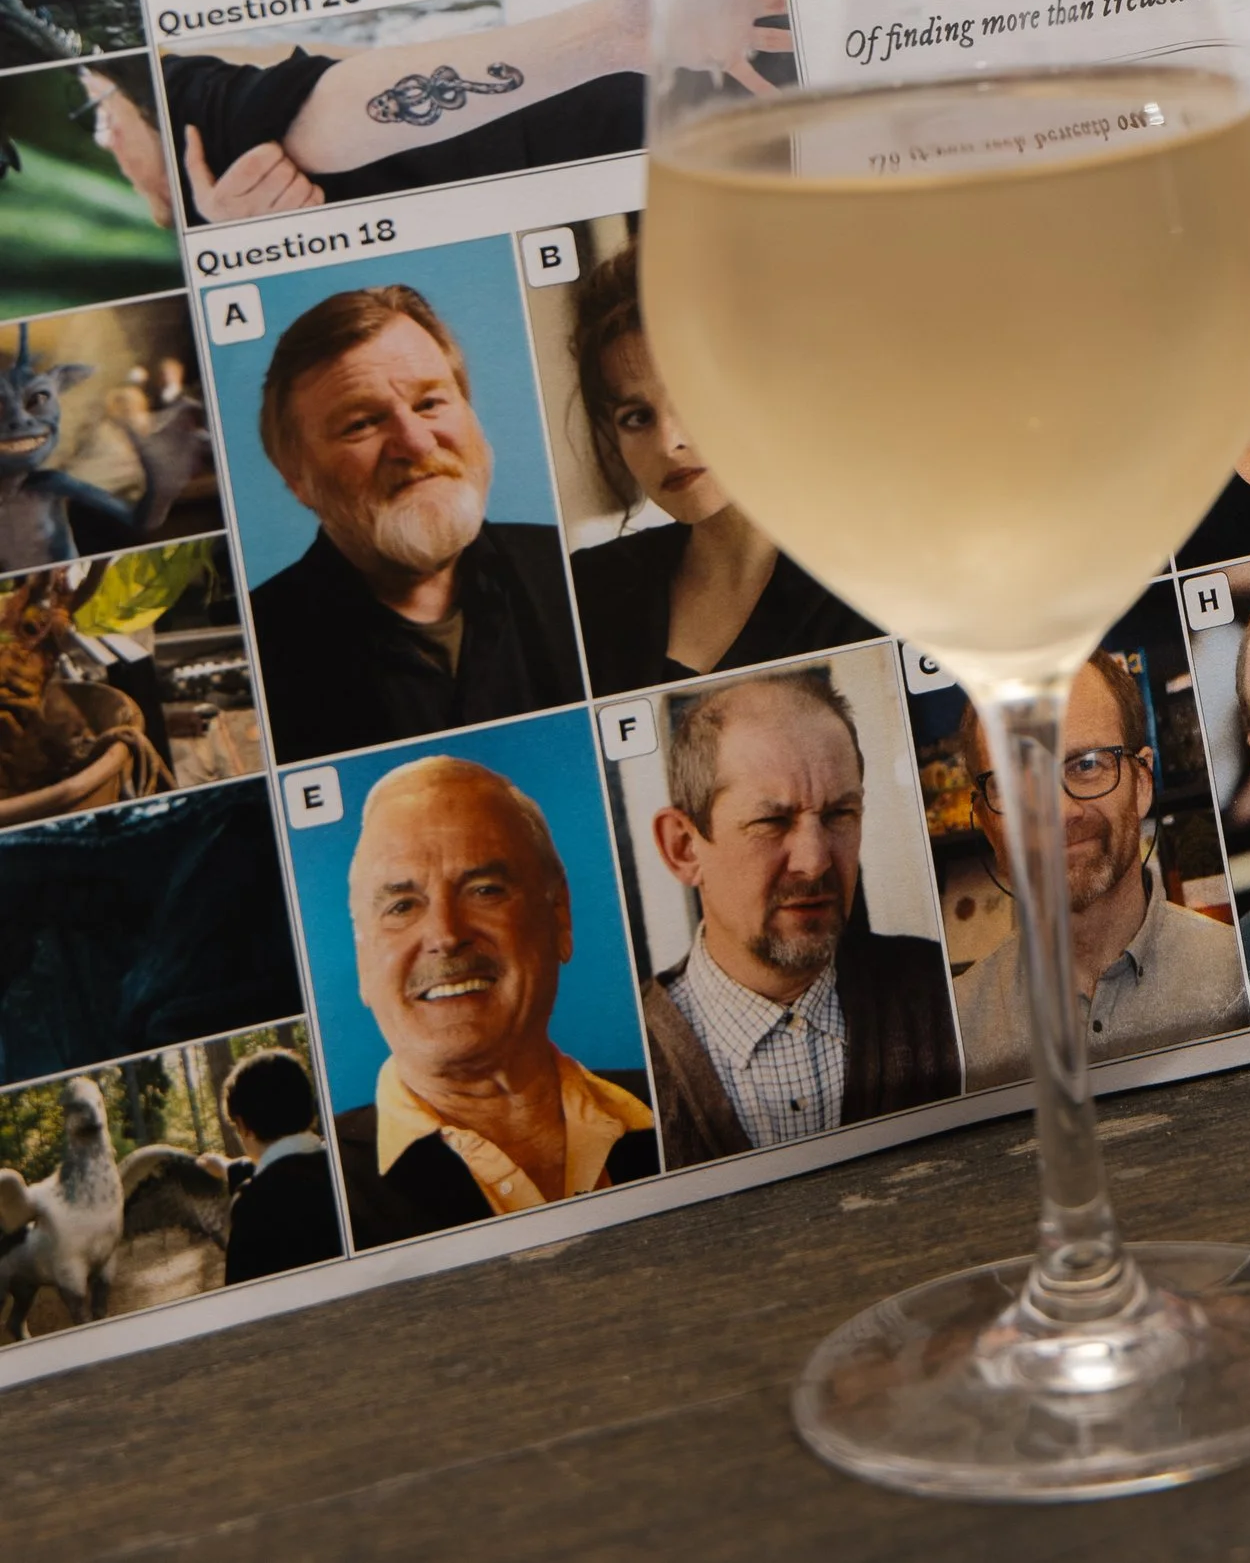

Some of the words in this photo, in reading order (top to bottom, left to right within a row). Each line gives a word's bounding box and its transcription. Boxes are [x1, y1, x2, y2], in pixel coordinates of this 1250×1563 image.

[846, 28, 882, 65] Of
[879, 16, 974, 68] finding
[981, 7, 1039, 37] more
[196, 234, 351, 276] Question
[358, 218, 396, 246] 18
[539, 245, 562, 269] B
[225, 302, 248, 327] A
[1197, 588, 1220, 614] H
[618, 716, 637, 742] F
[302, 784, 324, 810] E
